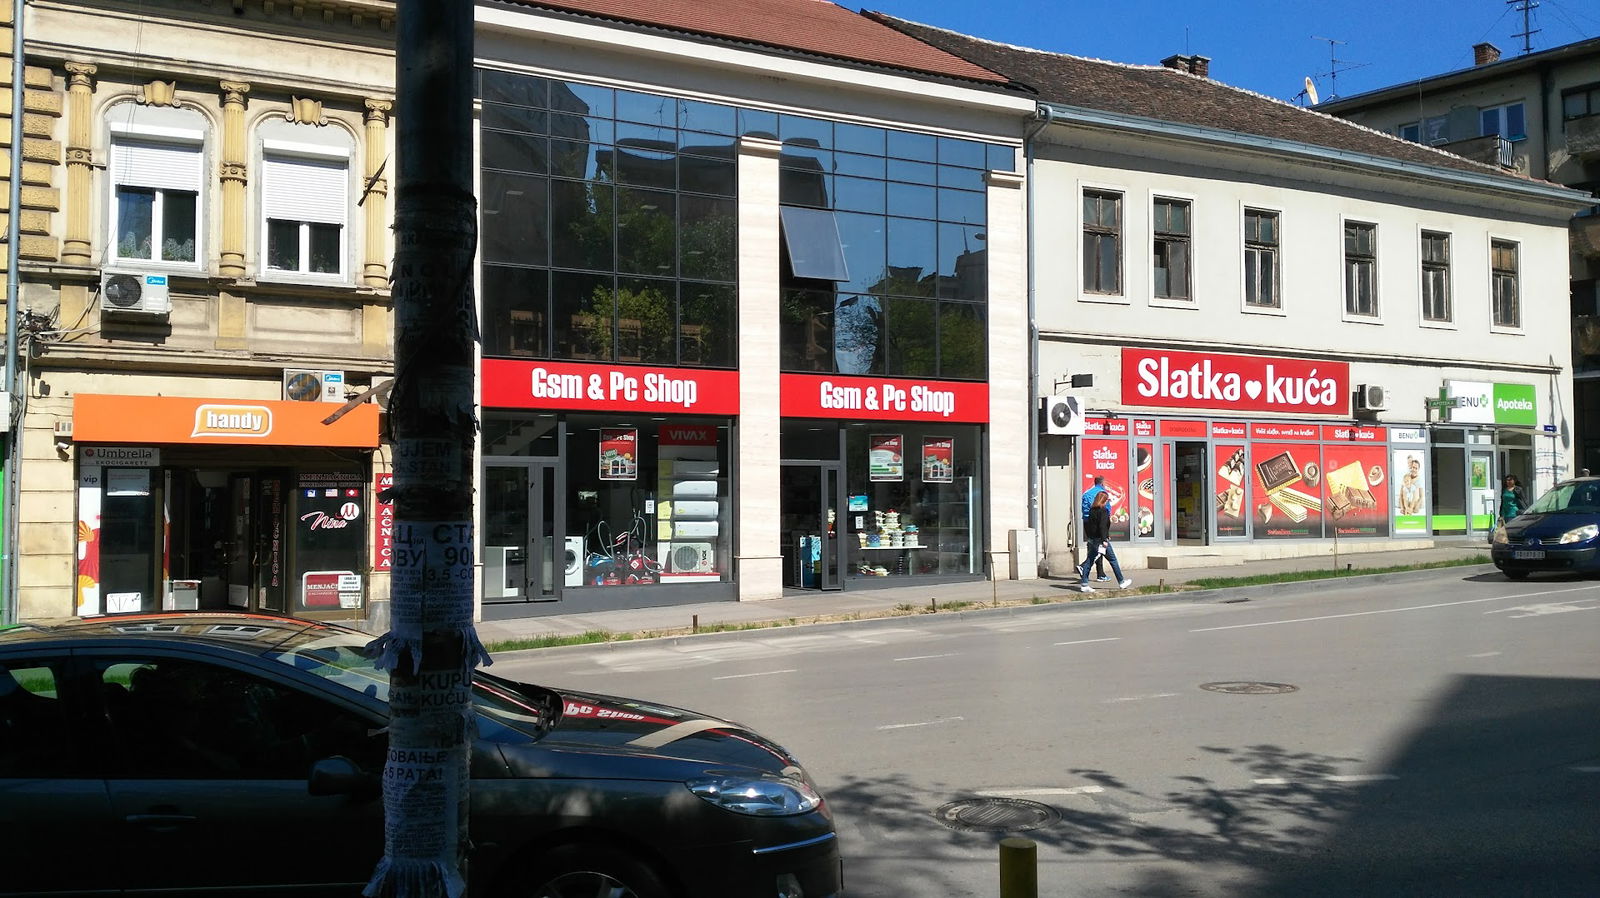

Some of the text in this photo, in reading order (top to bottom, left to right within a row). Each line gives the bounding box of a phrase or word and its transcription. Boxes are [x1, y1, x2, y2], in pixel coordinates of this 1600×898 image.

[532, 367, 697, 408] Gsm & Pc Shop
[1137, 356, 1337, 406] Slatka kuća
[820, 381, 955, 417] Gsm & Pc Shop
[1497, 398, 1533, 411] Apoteka
[206, 410, 263, 431] handy
[669, 430, 706, 440] VIVAX
[97, 449, 152, 459] Umbrella
[1093, 449, 1117, 460] Slatka
[1095, 460, 1115, 469] kuća
[83, 475, 98, 485] vip
[301, 511, 348, 530] Nina
